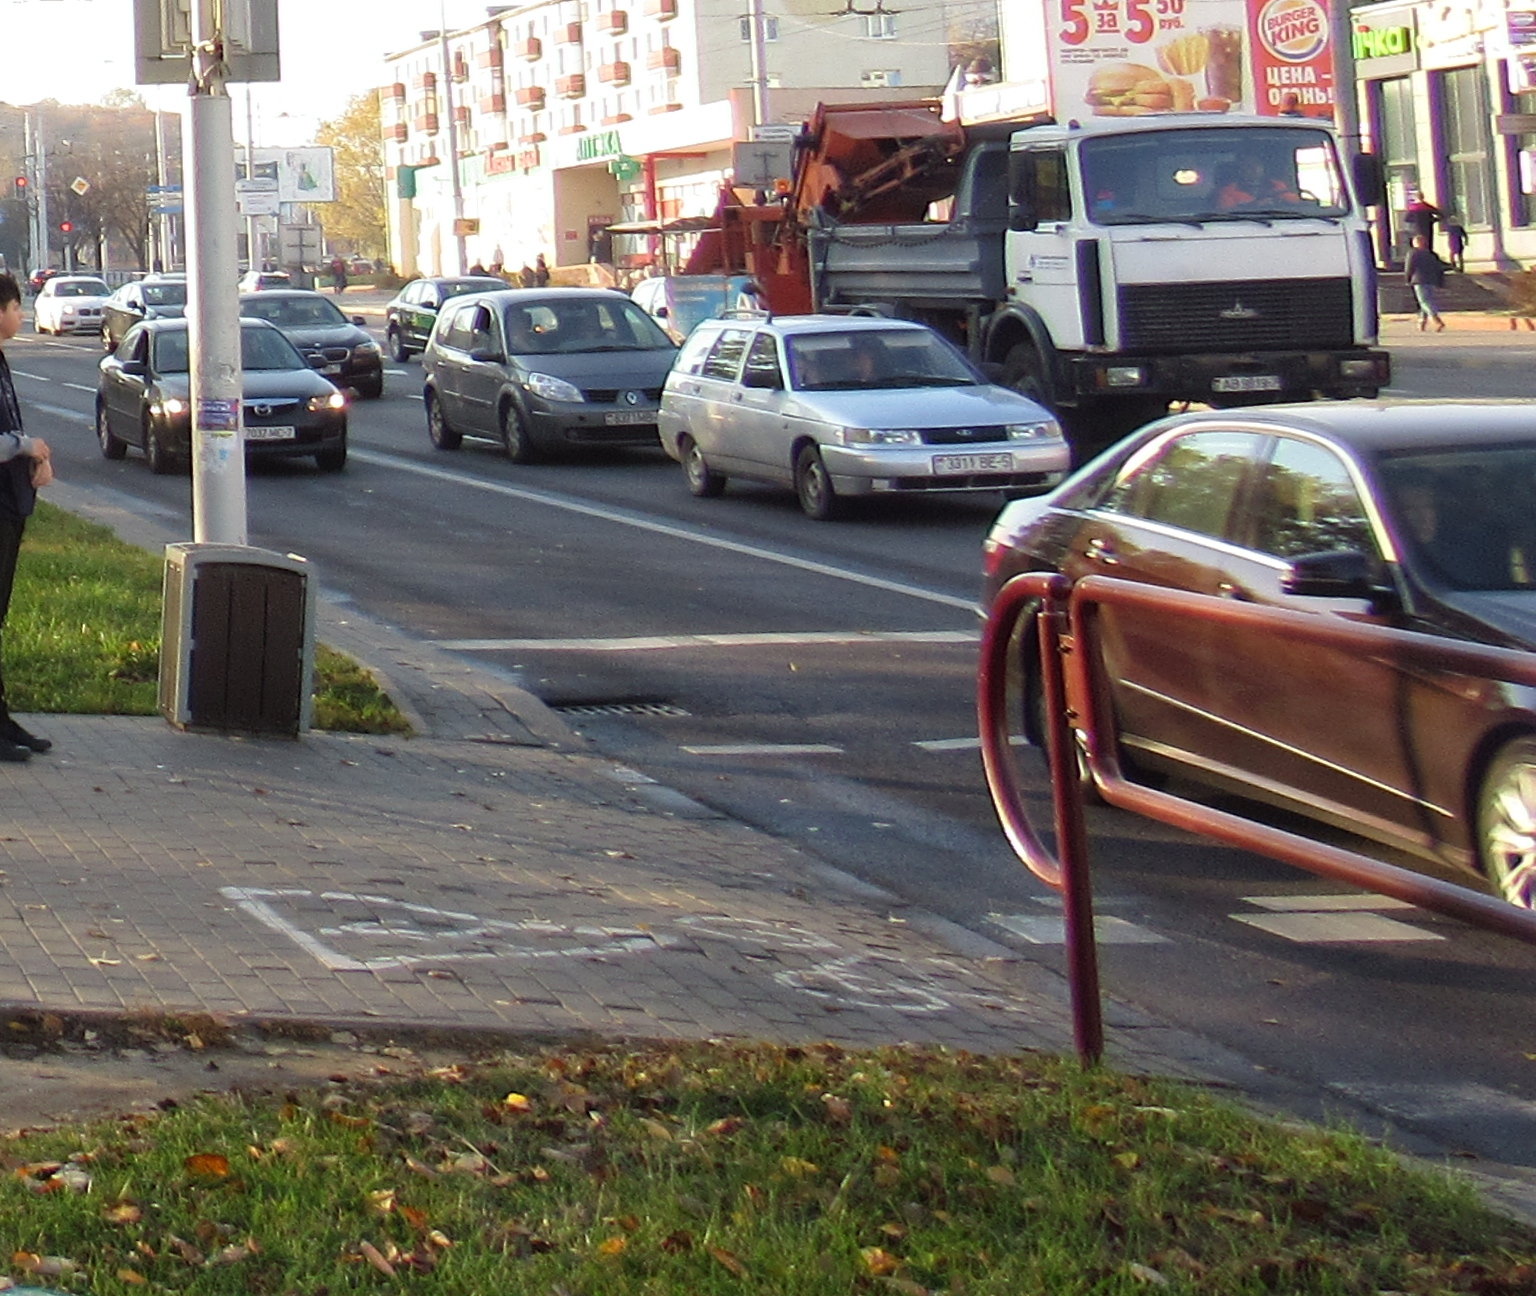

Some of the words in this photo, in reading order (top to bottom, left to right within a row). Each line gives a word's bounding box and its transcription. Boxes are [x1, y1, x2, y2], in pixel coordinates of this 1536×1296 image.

[1096, 12, 1117, 28] за
[1268, 7, 1315, 30] BURGER
[1272, 17, 1319, 47] KING
[1266, 66, 1316, 86] ЦЕНА
